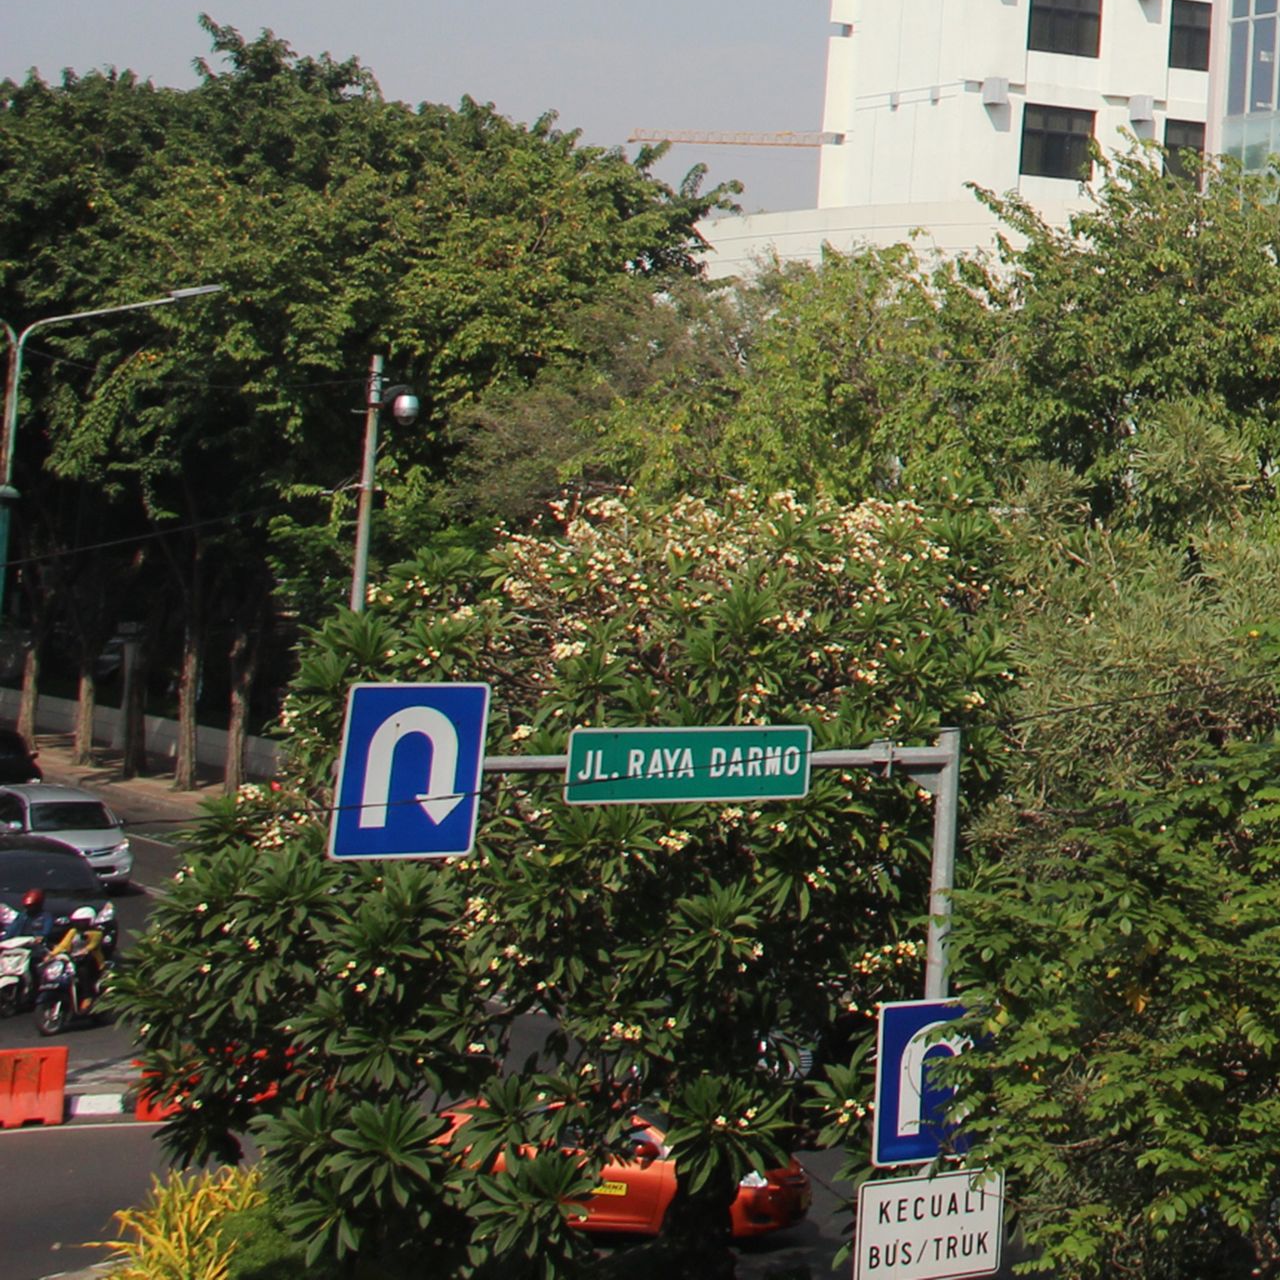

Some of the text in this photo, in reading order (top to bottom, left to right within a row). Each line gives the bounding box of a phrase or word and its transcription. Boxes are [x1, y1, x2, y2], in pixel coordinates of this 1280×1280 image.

[577, 745, 801, 781] JL. RAYA DARMO
[878, 1189, 985, 1224] KECUALI
[868, 1231, 989, 1269] BUS/TRUK
